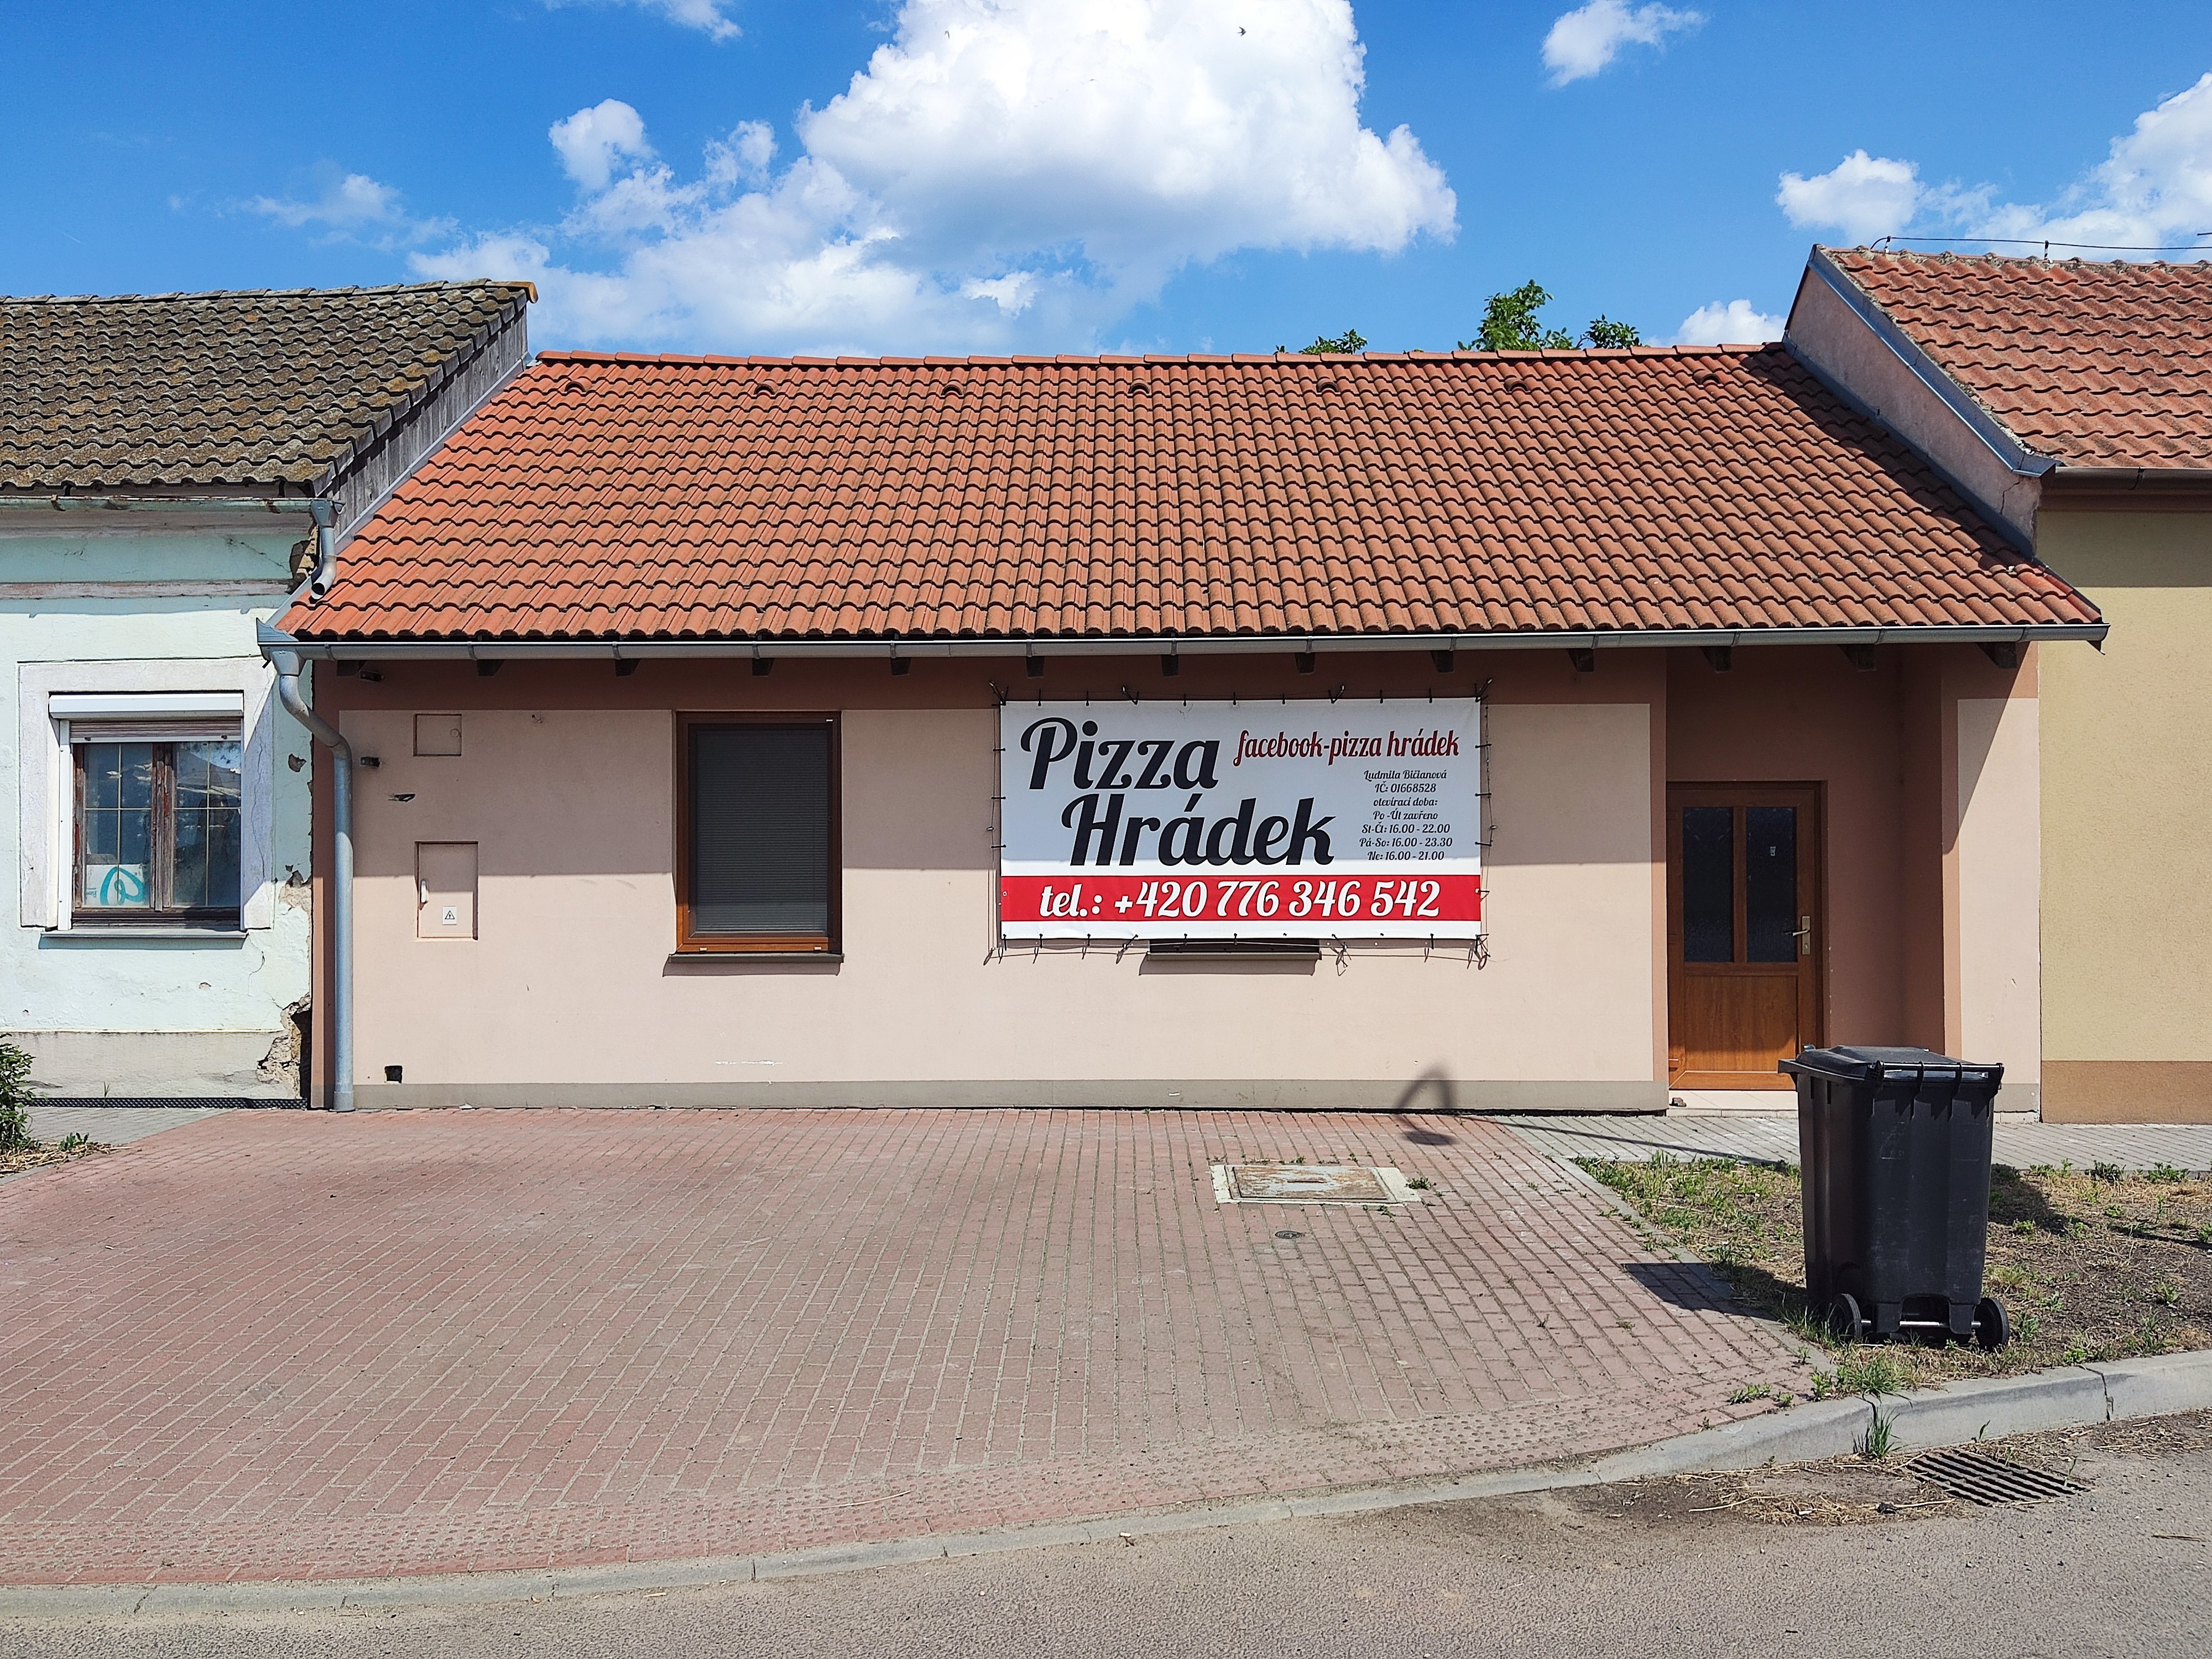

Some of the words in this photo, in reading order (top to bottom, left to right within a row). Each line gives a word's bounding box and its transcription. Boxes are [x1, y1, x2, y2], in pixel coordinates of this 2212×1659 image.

[1233, 729, 1382, 766] facebook-pizza
[1386, 728, 1459, 757] hrádek
[1020, 717, 1220, 790] Pizza
[1364, 770, 1400, 782] Ludmila
[1374, 781, 1389, 793] IČ:
[1390, 782, 1437, 793] 01668528
[1373, 797, 1411, 806] otevírací
[1412, 797, 1438, 806] doba:
[1373, 810, 1385, 820] Po
[1403, 810, 1438, 820] zavřeno
[1061, 792, 1337, 867] Hrádek
[1361, 821, 1387, 833] St-Čt:
[1389, 823, 1415, 833] 16.00
[1422, 823, 1451, 833] 22.00
[1359, 837, 1390, 847] Pá-So:
[1391, 837, 1417, 847] 16.00
[1425, 837, 1453, 847] 23.30
[1367, 851, 1383, 860] Ne:
[1385, 851, 1411, 860] 16.00
[1418, 851, 1444, 860] 21.00
[1040, 884, 1102, 917] tel.:
[1114, 880, 1207, 917] +420
[1217, 880, 1279, 917] 776
[1288, 880, 1360, 917] 346
[1370, 880, 1440, 917] 542
